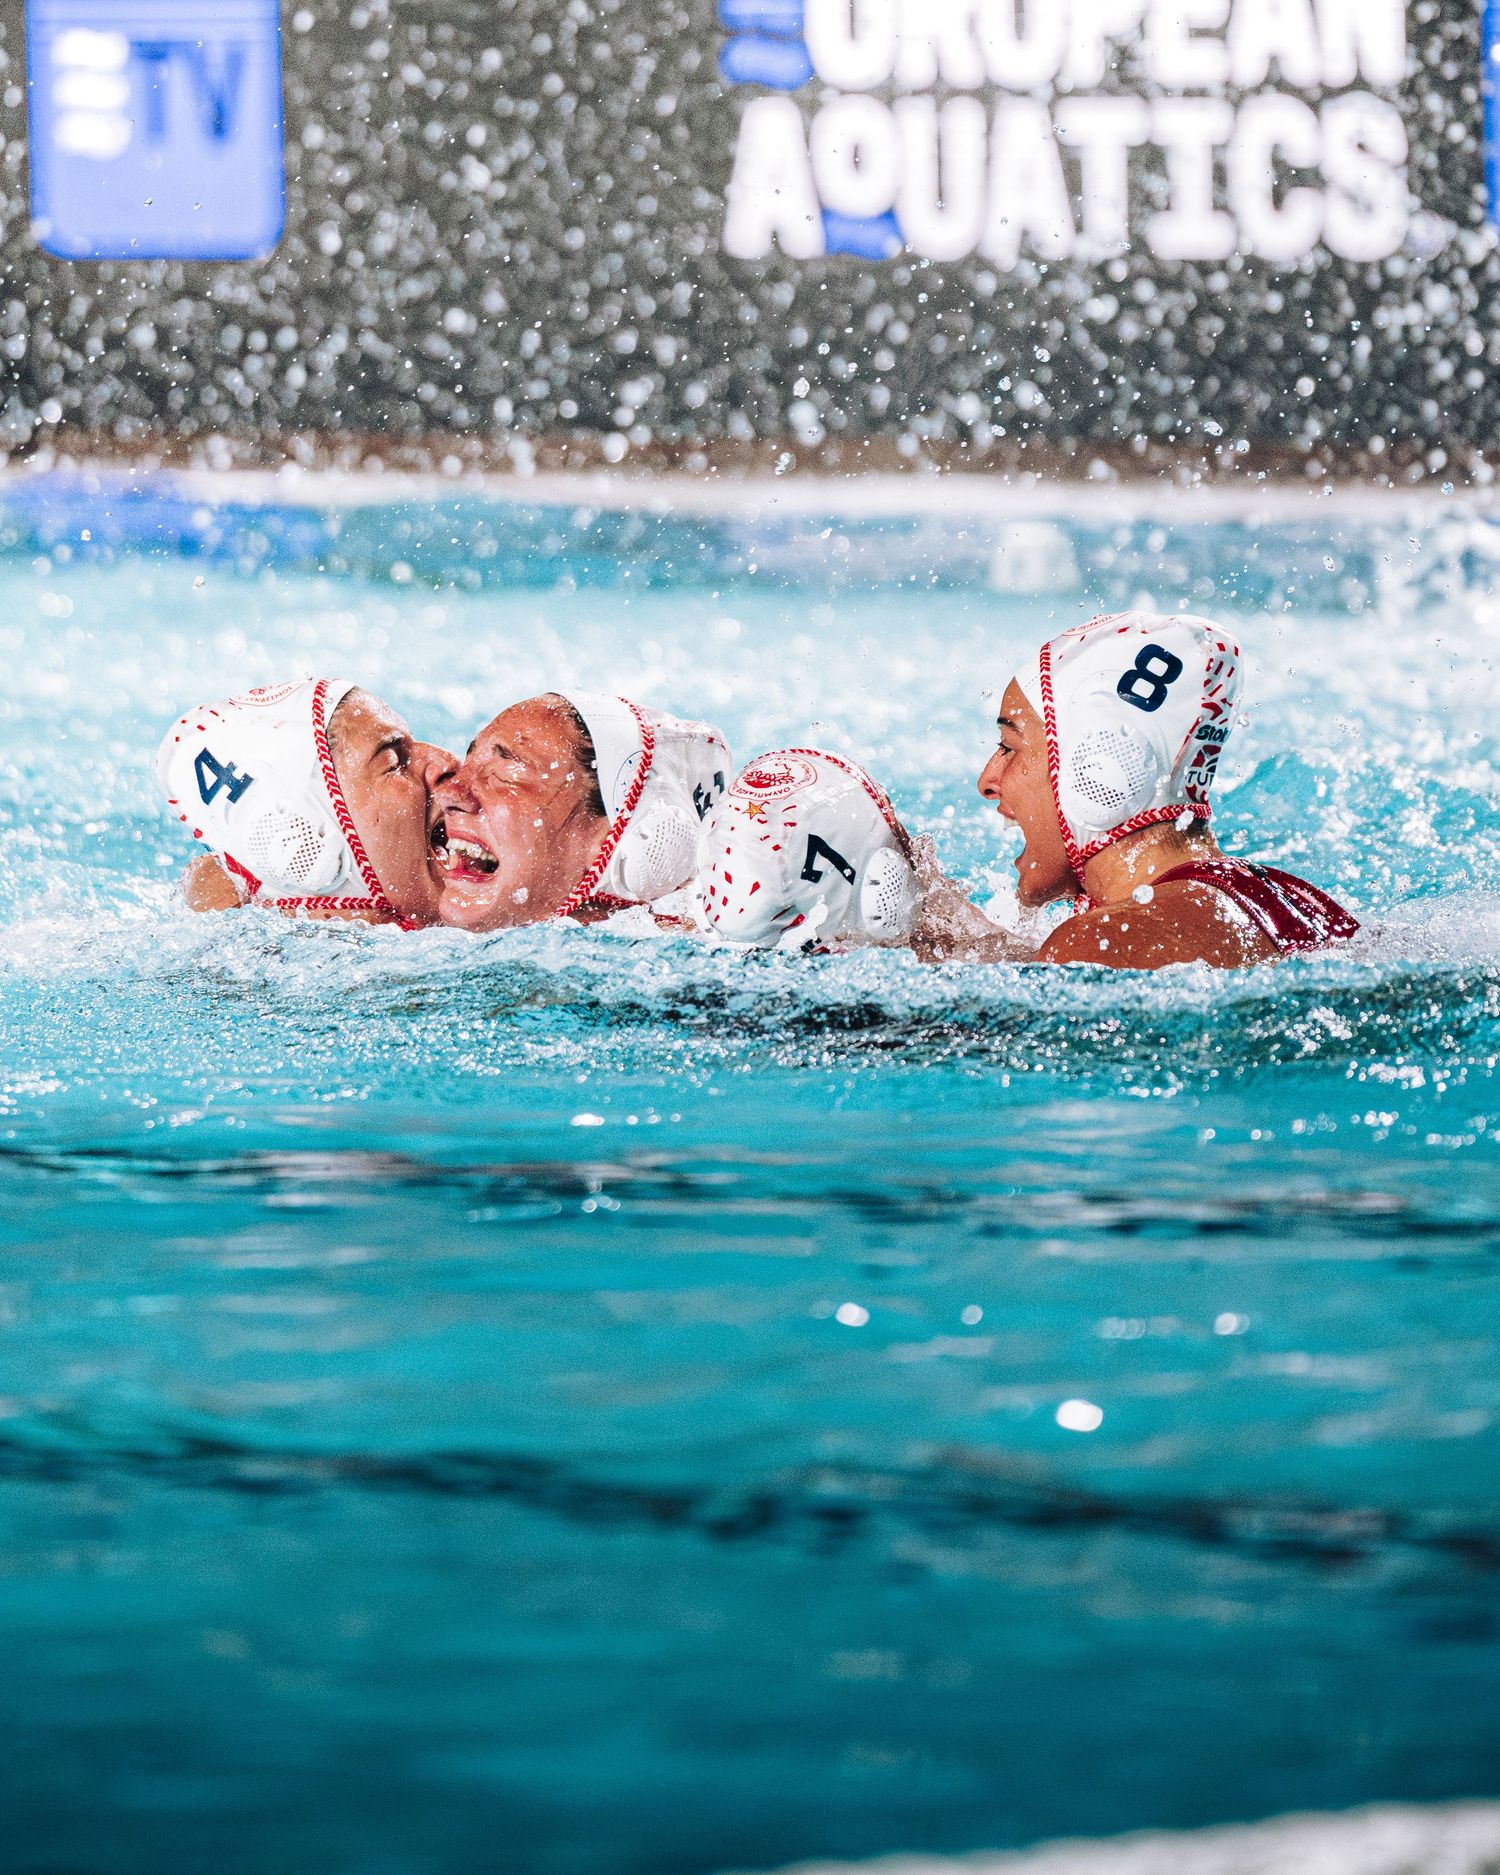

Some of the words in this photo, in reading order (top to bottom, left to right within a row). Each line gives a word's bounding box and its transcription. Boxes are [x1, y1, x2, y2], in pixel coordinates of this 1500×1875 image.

[723, 90, 1410, 263] AQUATICS
[1116, 643, 1184, 713] 8
[194, 747, 254, 805] 4
[800, 833, 856, 886] 7
